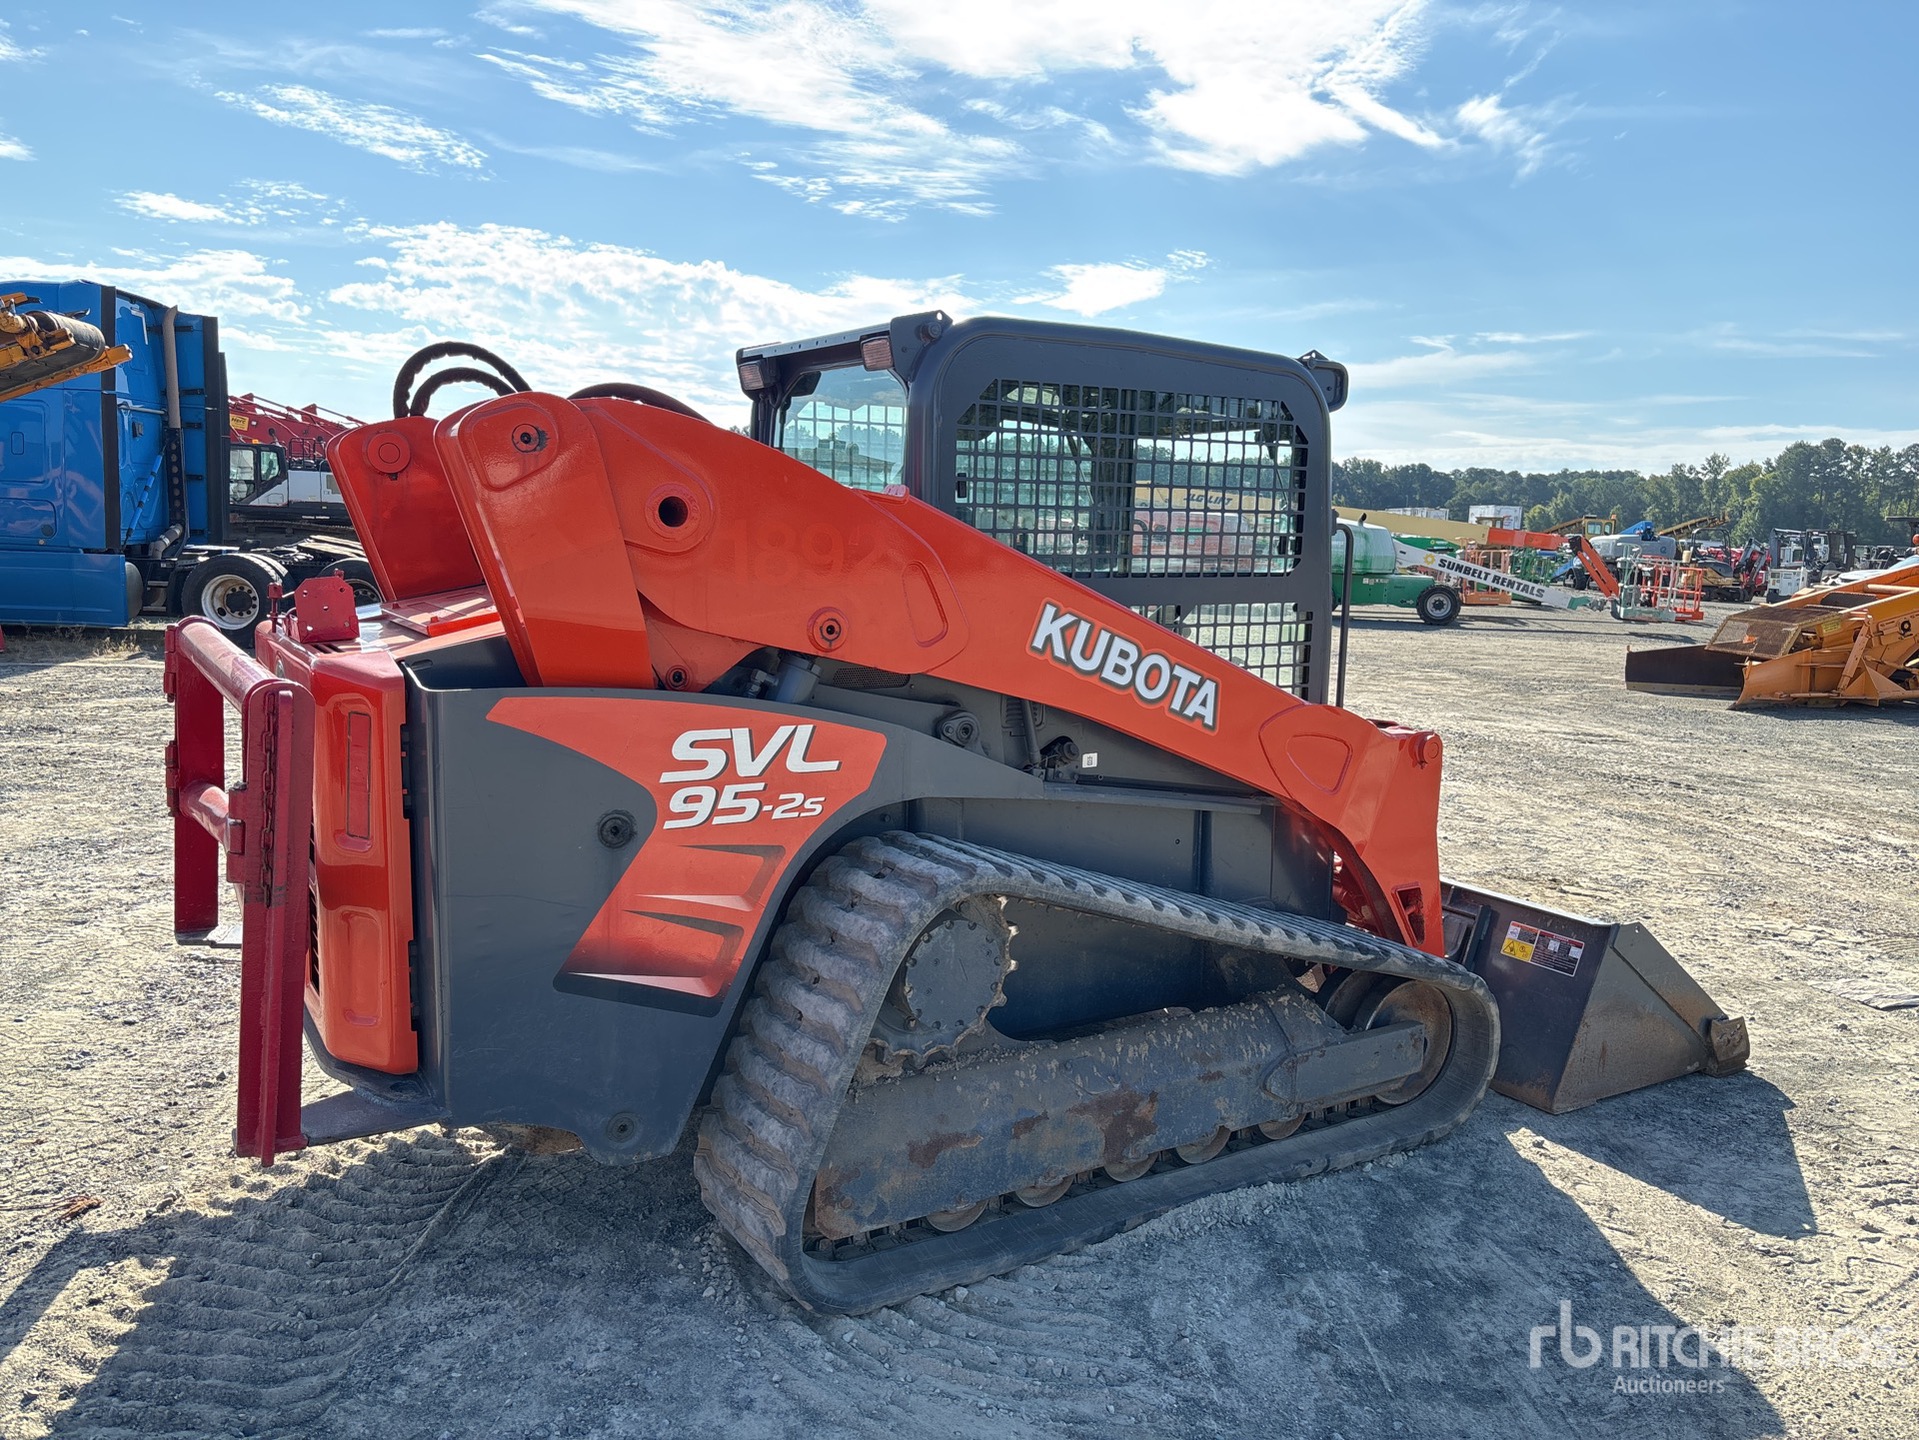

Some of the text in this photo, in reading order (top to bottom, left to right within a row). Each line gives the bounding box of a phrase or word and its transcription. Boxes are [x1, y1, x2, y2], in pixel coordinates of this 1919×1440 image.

[1438, 558, 1545, 599] SUNBELT RENTALS
[1031, 601, 1219, 729] KUBOTA
[658, 724, 842, 784] SVL
